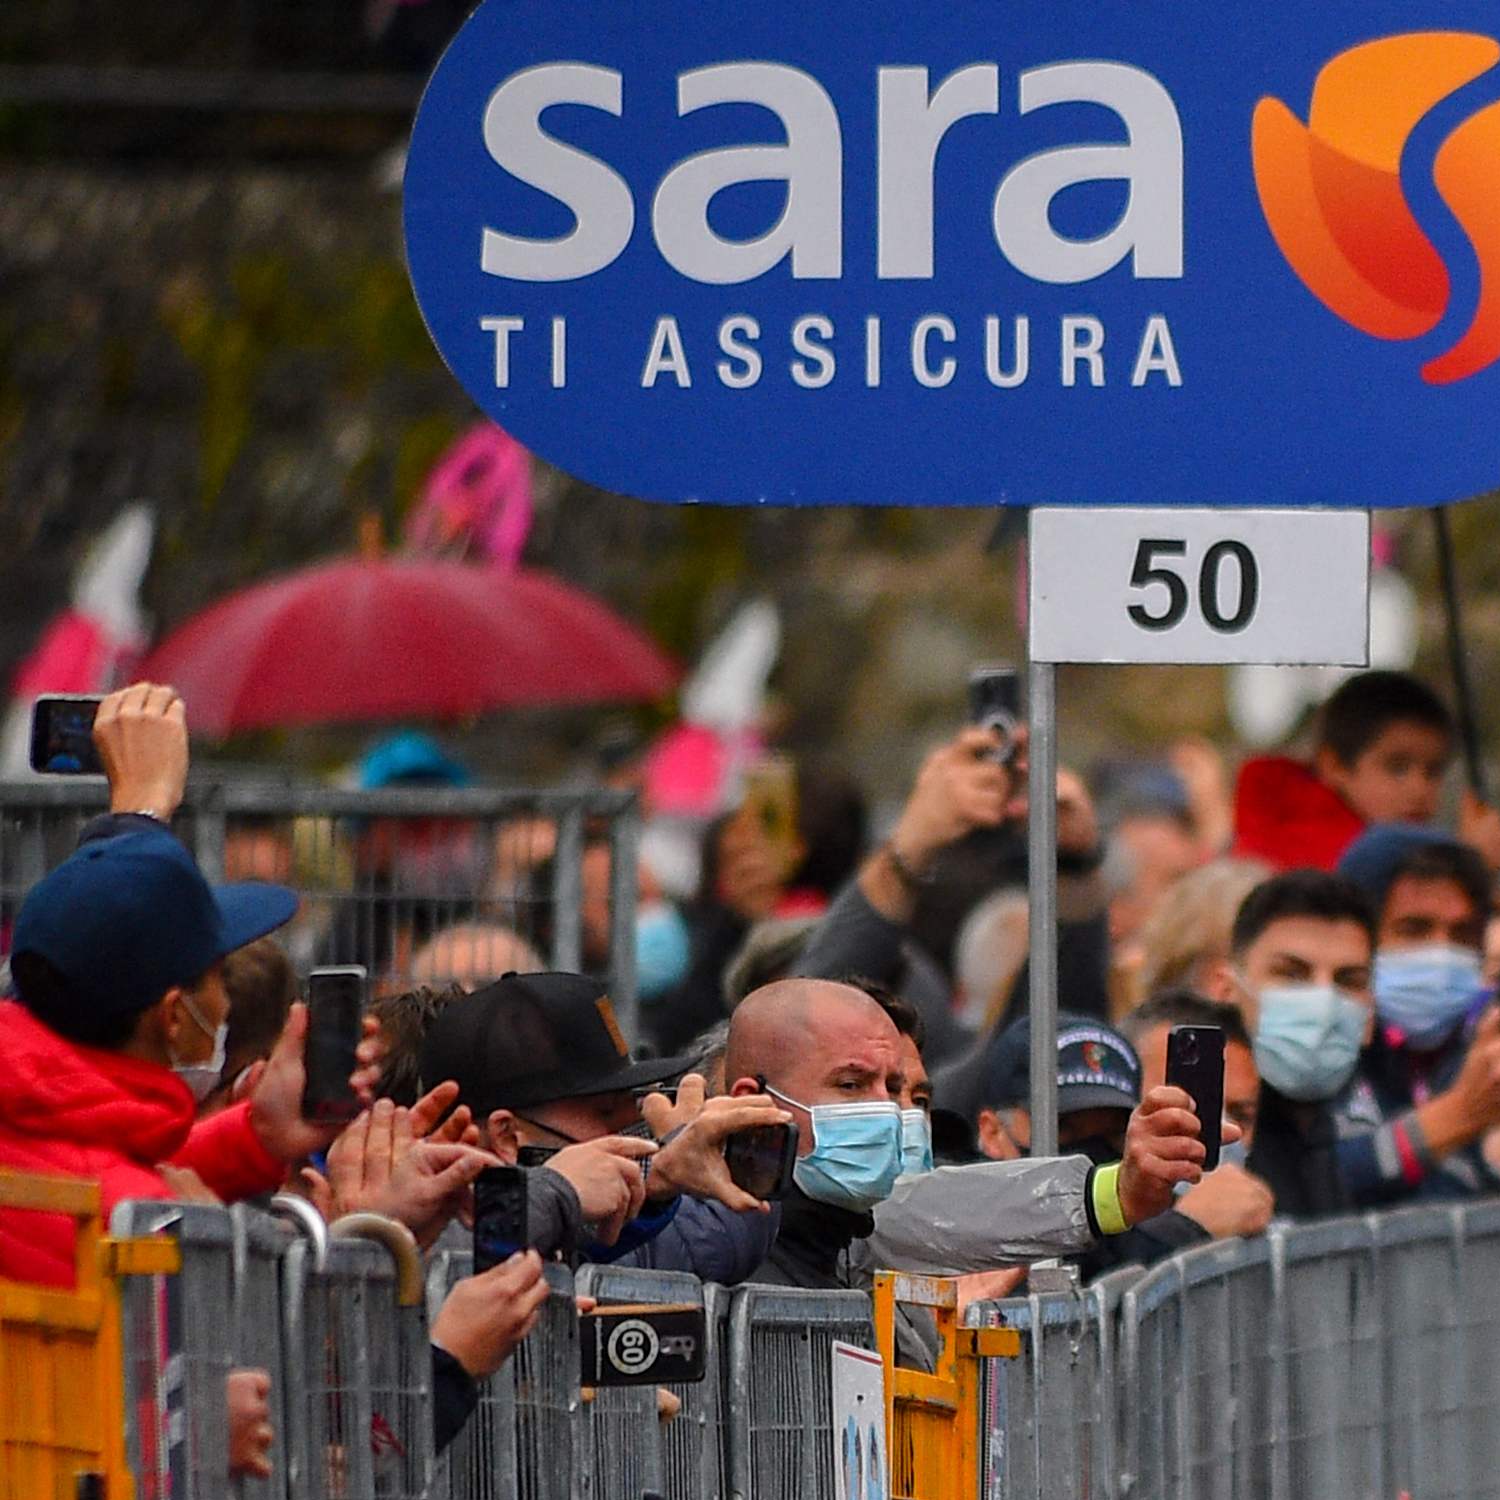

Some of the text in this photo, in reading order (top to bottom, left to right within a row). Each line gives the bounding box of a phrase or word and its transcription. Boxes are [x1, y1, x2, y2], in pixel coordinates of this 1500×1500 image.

[481, 61, 1184, 283] sara
[480, 315, 1184, 390] TI ASSICURA
[1125, 538, 1261, 634] 50
